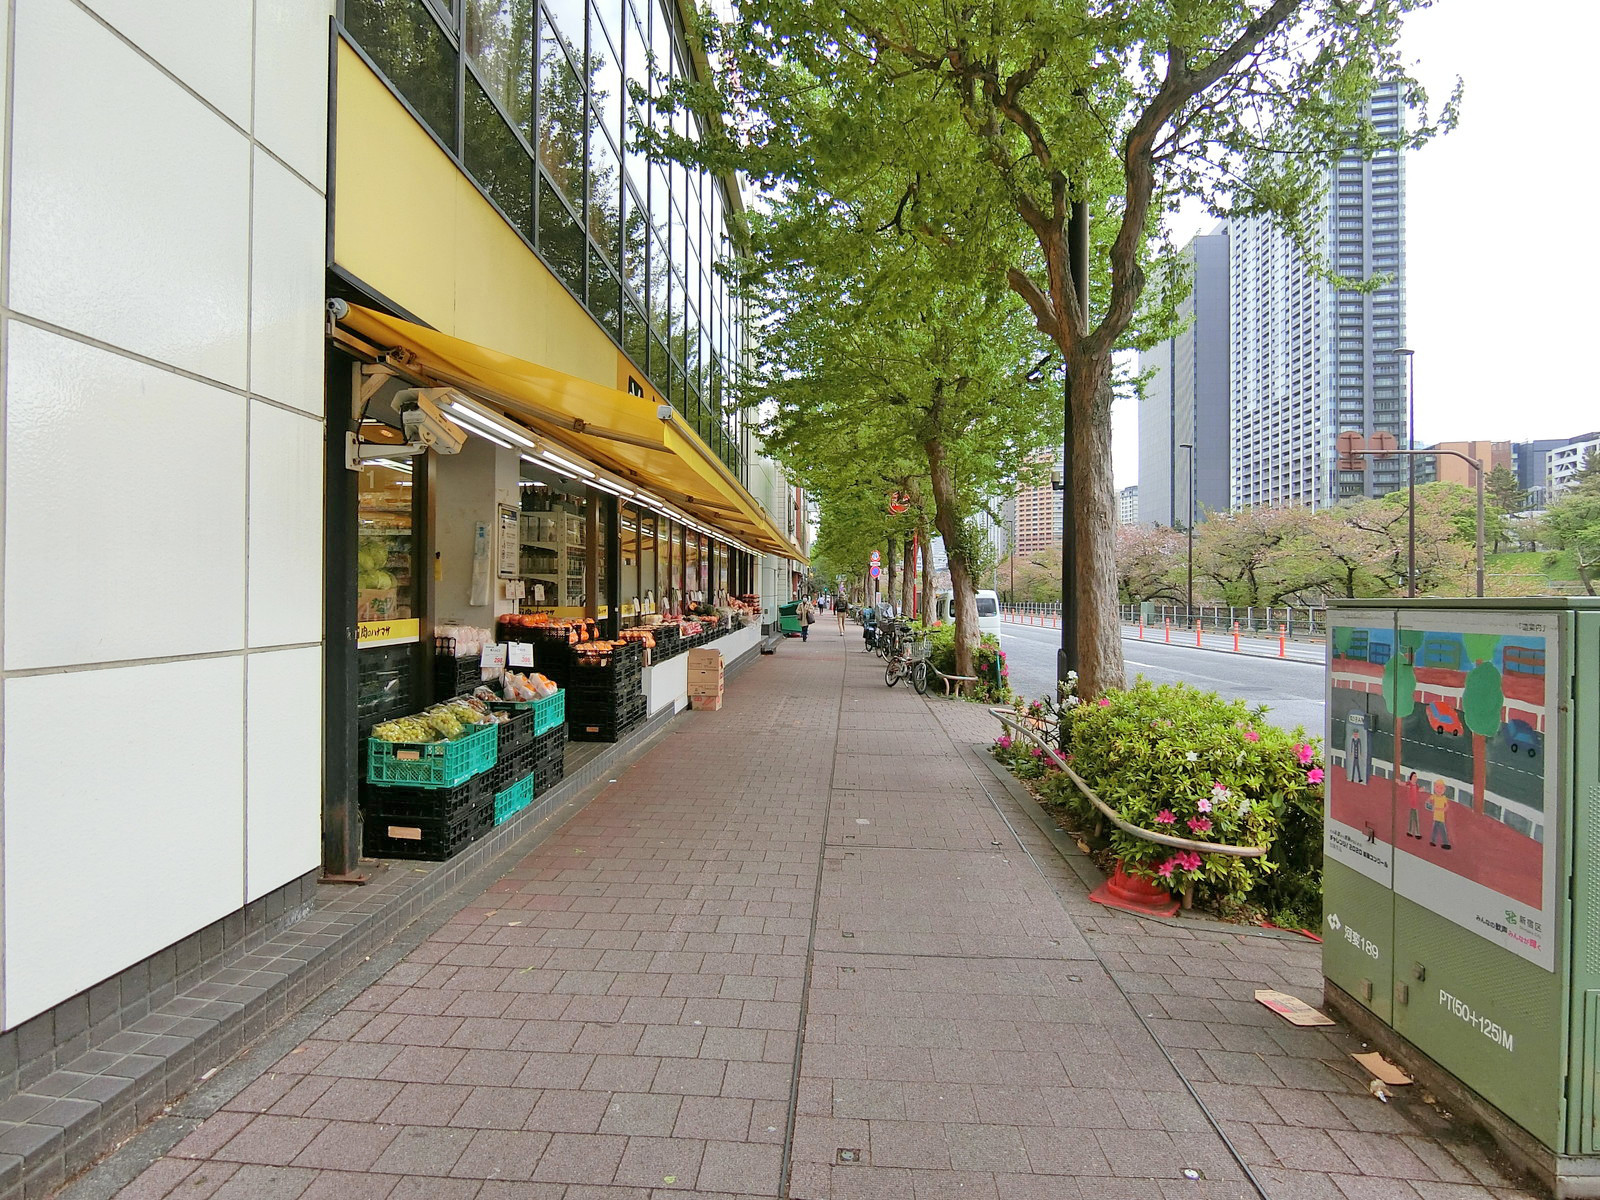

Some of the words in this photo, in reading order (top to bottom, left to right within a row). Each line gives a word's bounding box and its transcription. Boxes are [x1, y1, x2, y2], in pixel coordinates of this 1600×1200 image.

[1519, 915, 1542, 933] 新宿区
[1439, 988, 1513, 1053] PT(50+125)M
